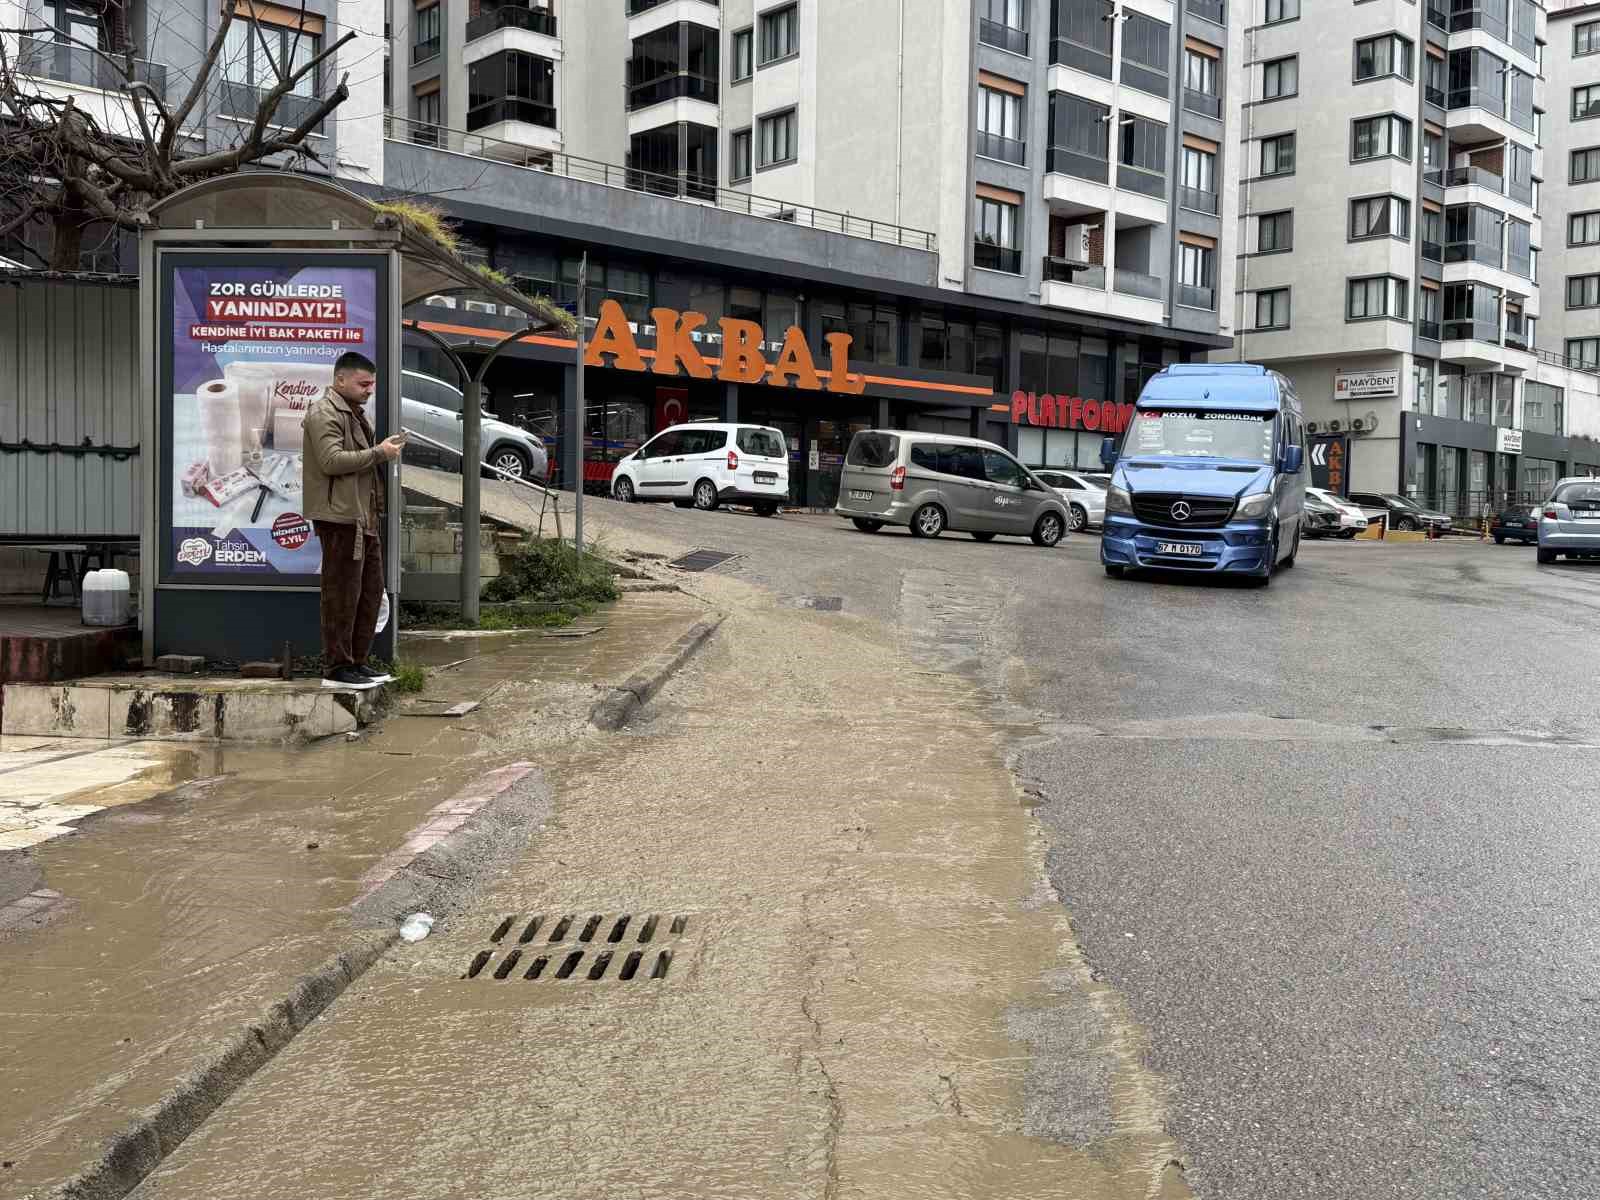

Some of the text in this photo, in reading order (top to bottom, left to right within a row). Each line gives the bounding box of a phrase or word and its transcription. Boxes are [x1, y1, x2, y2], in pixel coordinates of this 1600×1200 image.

[210, 280, 343, 298] ZOR GÜNLERDE
[209, 300, 342, 318] YANINDAYIZ!
[192, 324, 247, 337] KENDİNE
[249, 325, 266, 337] İYİ
[269, 327, 295, 338] BAK
[298, 327, 343, 339] PAKETİ
[201, 342, 283, 354] Hastalarımızın
[584, 299, 866, 395] AKBAL
[1349, 376, 1396, 387] MAYDENT
[273, 380, 320, 401] Kendine
[1011, 390, 1136, 432] PLATFORM
[1162, 411, 1264, 422] KOZLU ZONGULDAK
[215, 540, 249, 551] Tahsin
[215, 551, 266, 563] ERDEM
